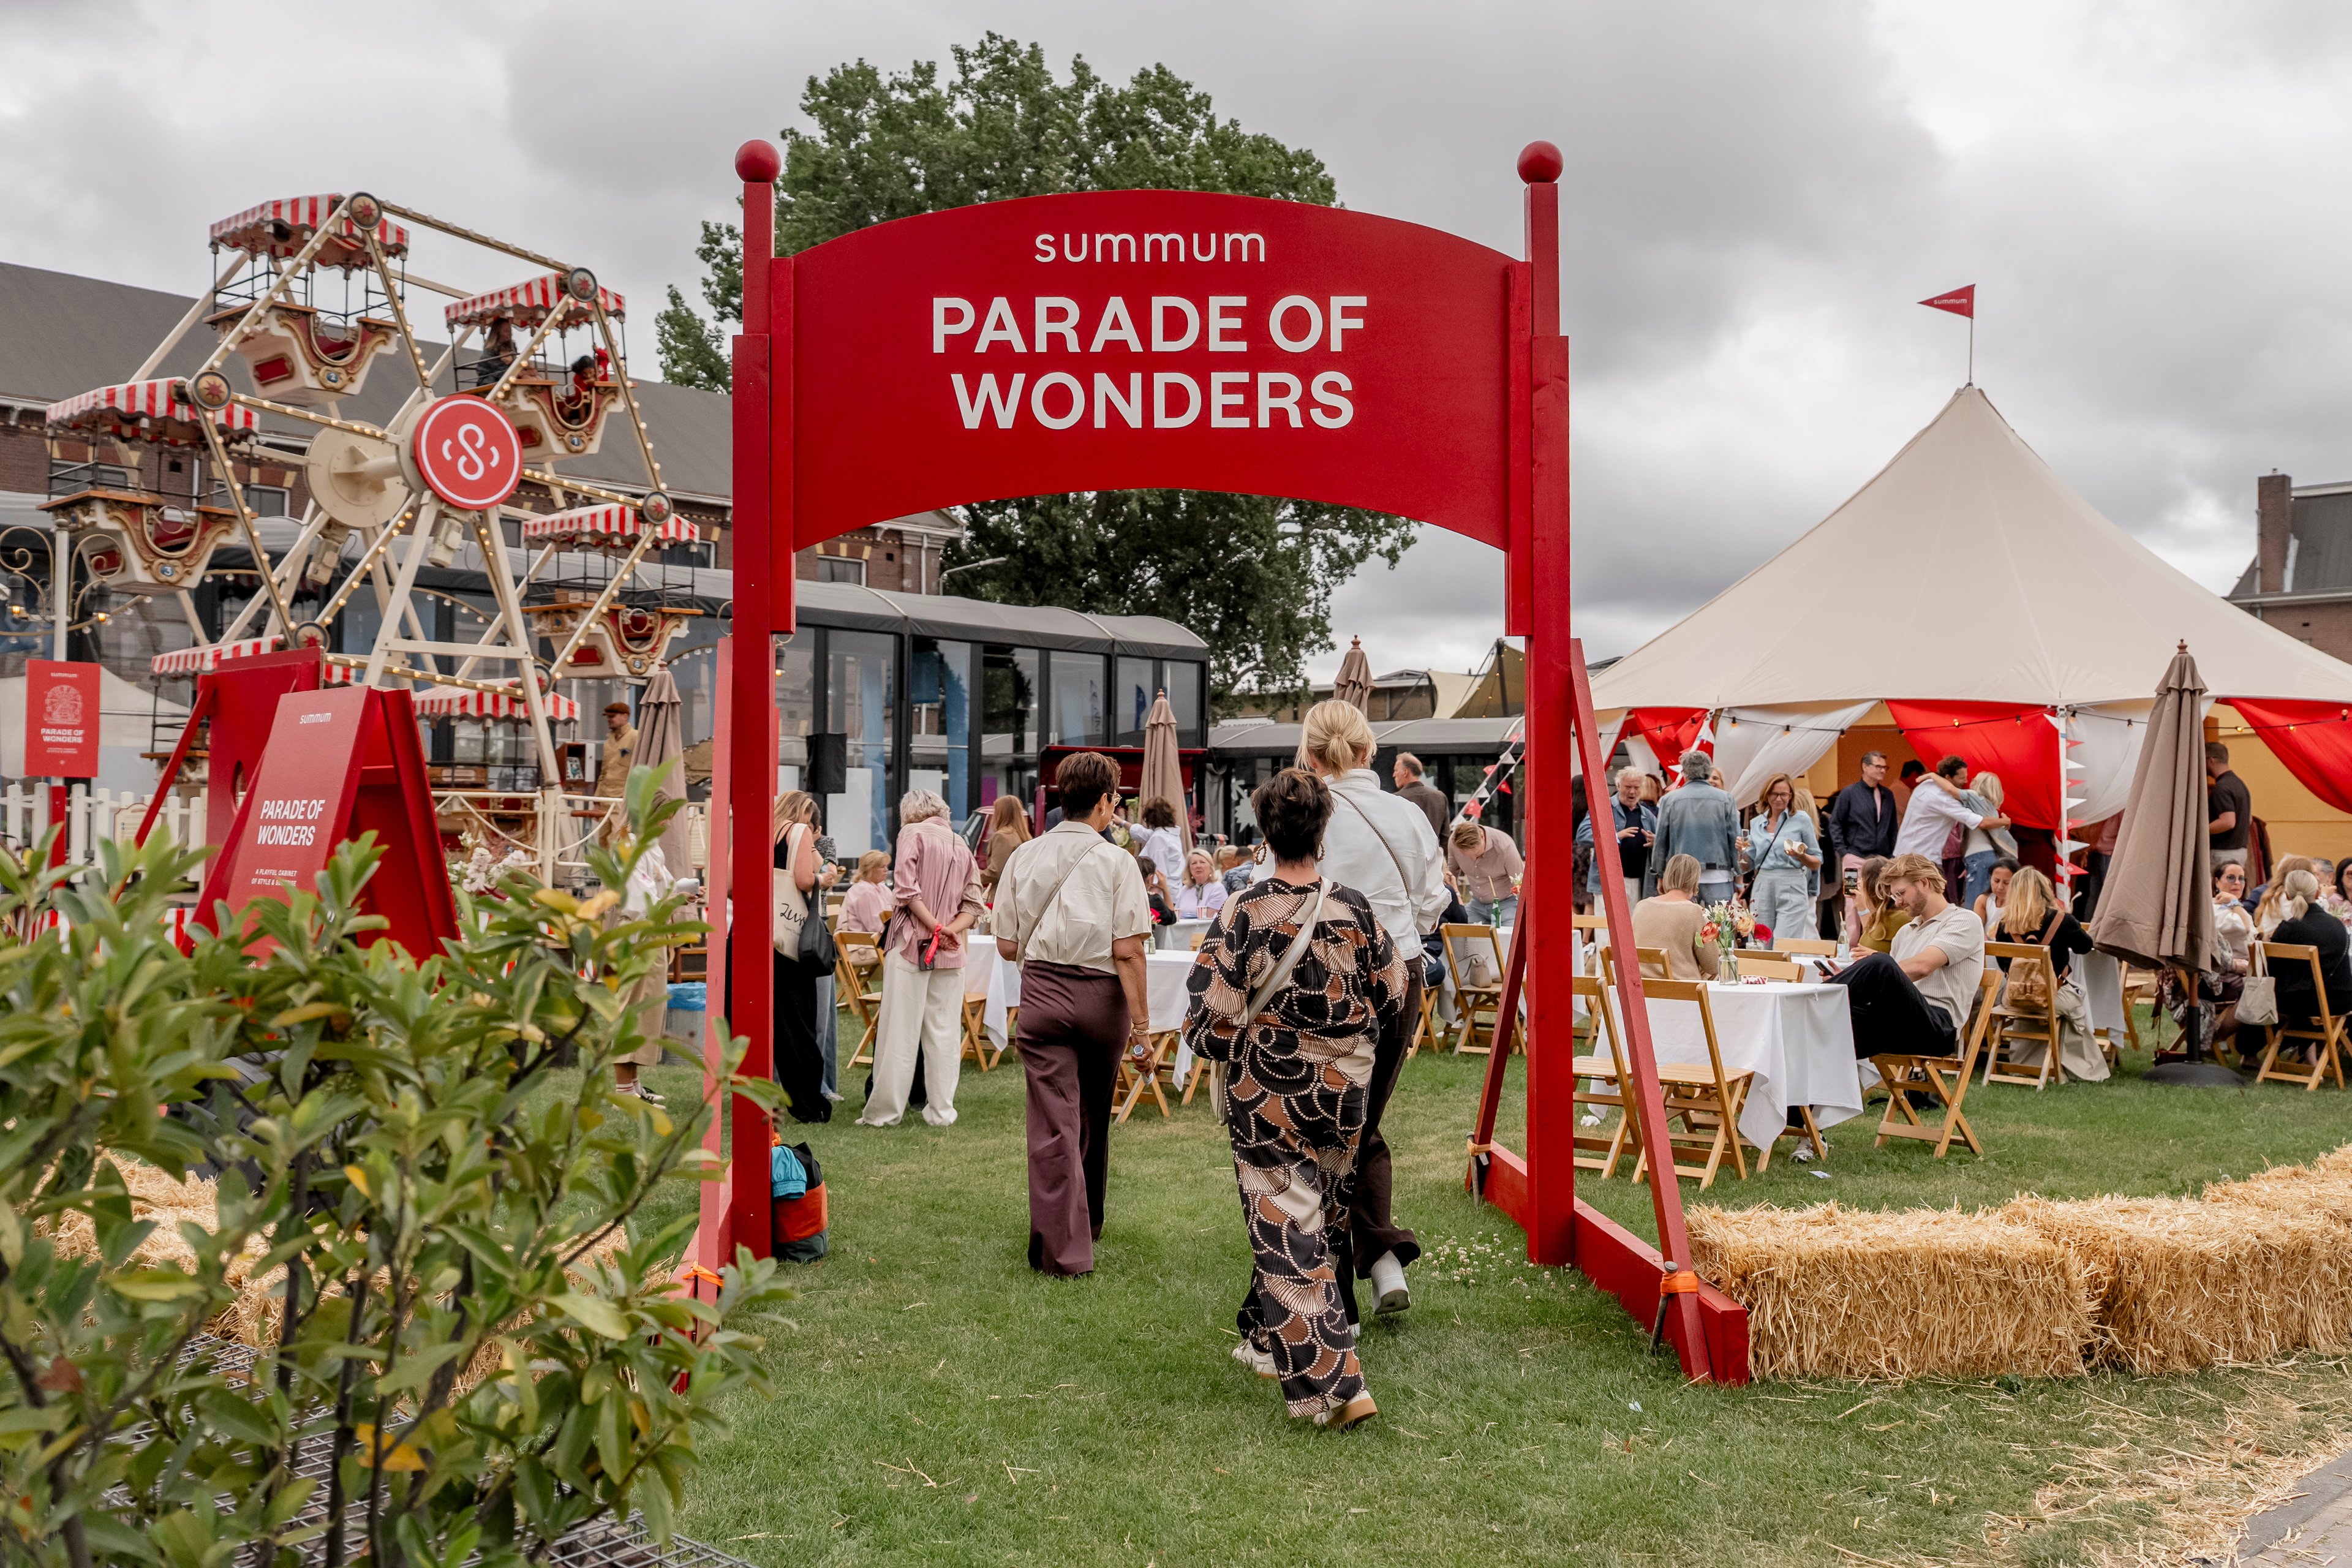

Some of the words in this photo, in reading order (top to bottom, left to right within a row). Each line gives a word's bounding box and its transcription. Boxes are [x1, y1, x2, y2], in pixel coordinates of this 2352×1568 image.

[1035, 233, 1266, 263] summum
[932, 296, 1248, 354] PARADE
[1268, 295, 1368, 353] OF
[950, 370, 1354, 430] WONDERS
[300, 712, 331, 724] summum
[260, 800, 308, 820] PARADE
[307, 799, 326, 820] OF
[257, 825, 315, 846] WONDERS
